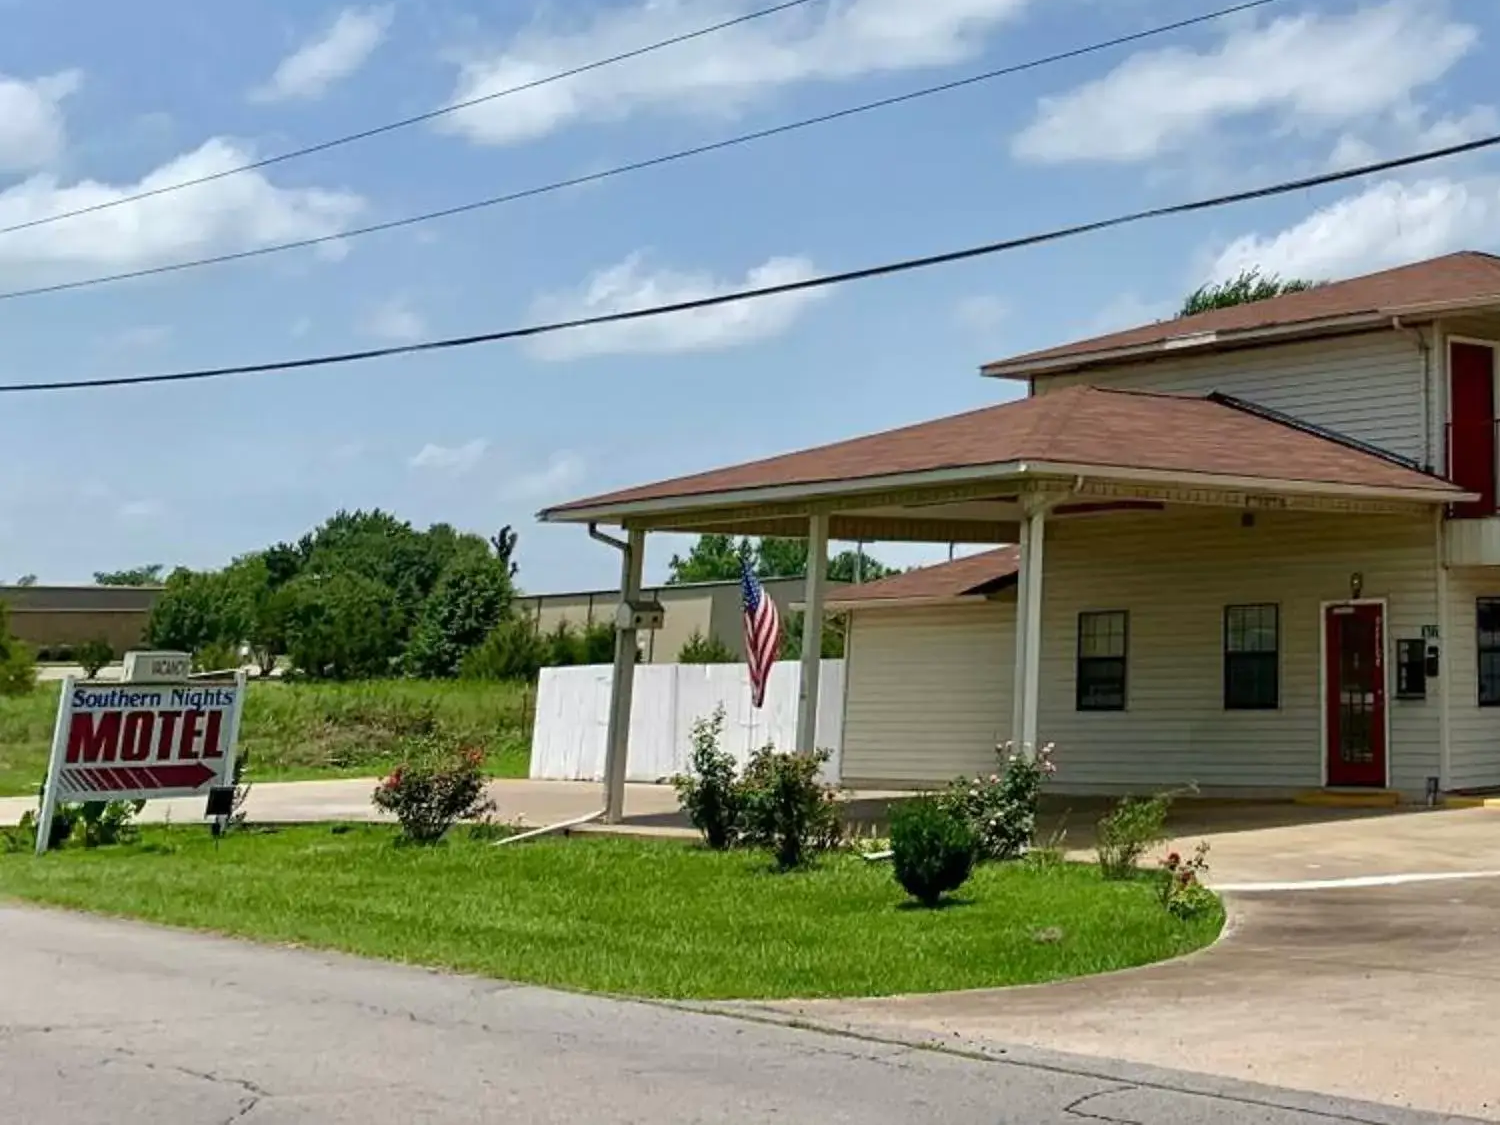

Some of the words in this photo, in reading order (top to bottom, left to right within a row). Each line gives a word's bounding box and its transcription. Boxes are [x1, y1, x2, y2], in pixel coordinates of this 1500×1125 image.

[72, 689, 161, 708] Southern
[170, 689, 233, 711] Nights
[65, 709, 224, 763] MOTEL
